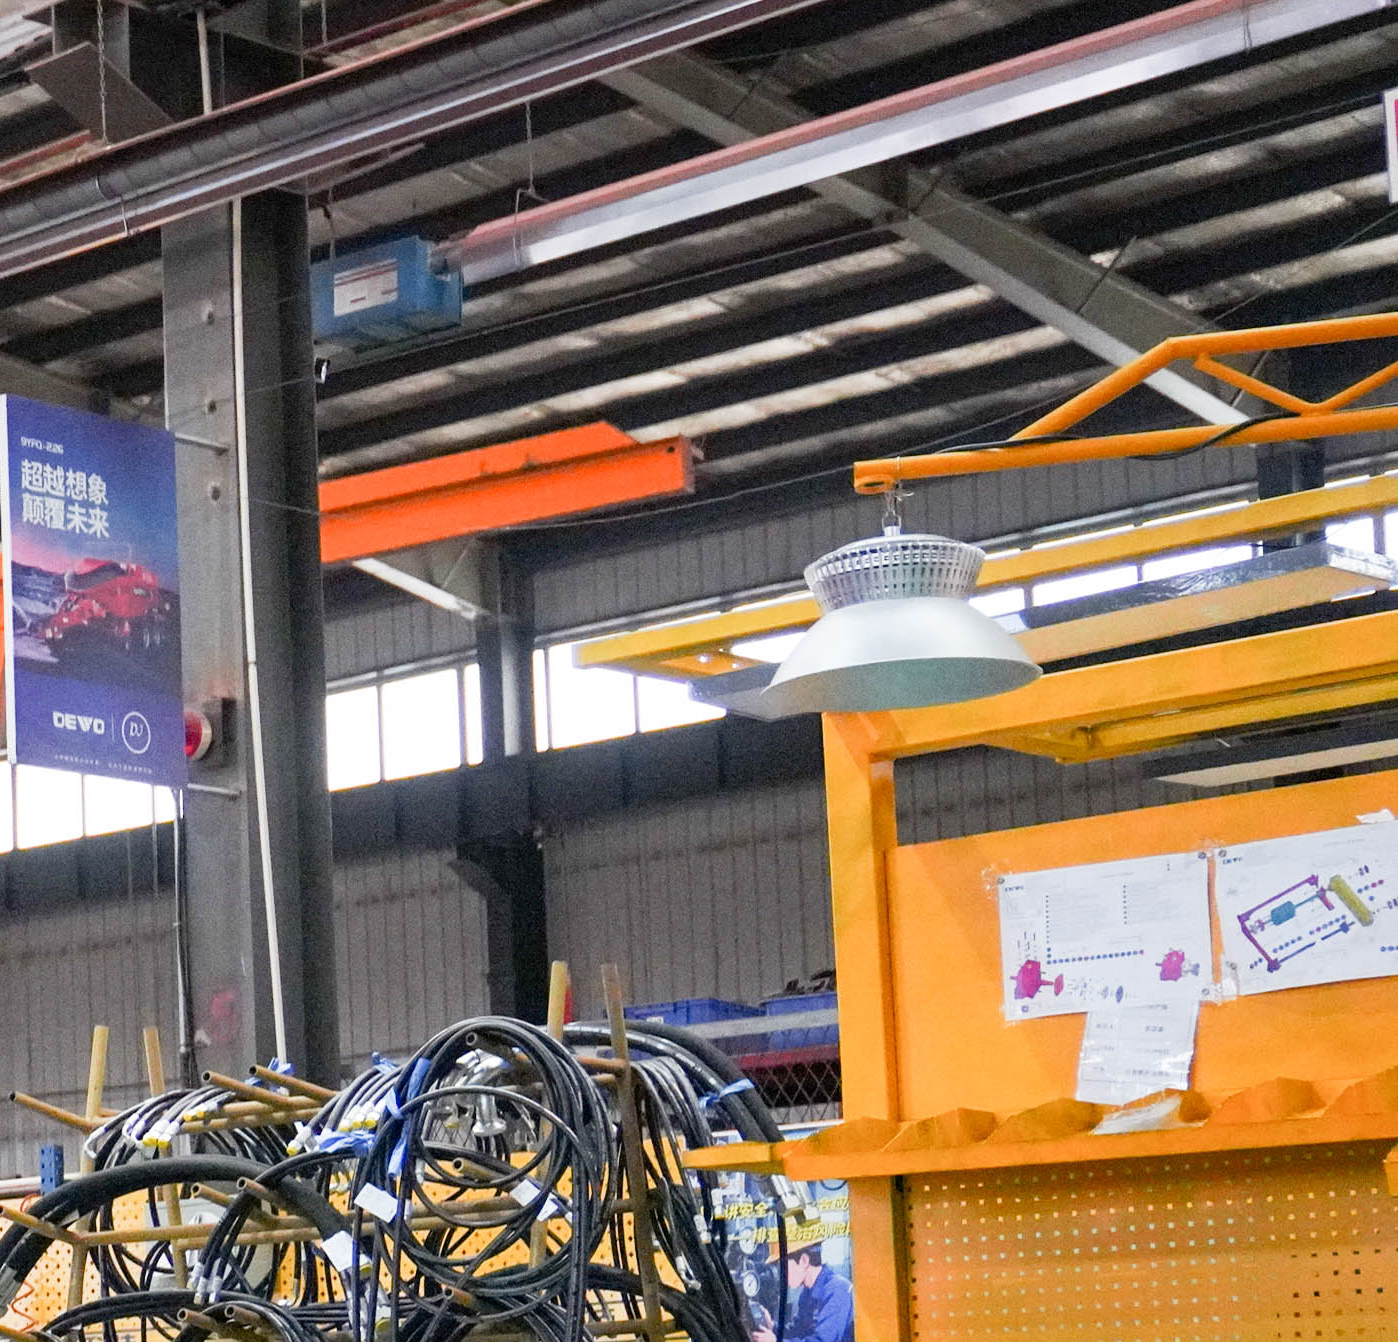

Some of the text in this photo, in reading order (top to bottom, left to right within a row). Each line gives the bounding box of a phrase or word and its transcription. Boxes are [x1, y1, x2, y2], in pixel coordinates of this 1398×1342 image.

[21, 458, 109, 505] 超越想象
[22, 492, 110, 539] 颠覆未来
[52, 711, 105, 735] DEWO
